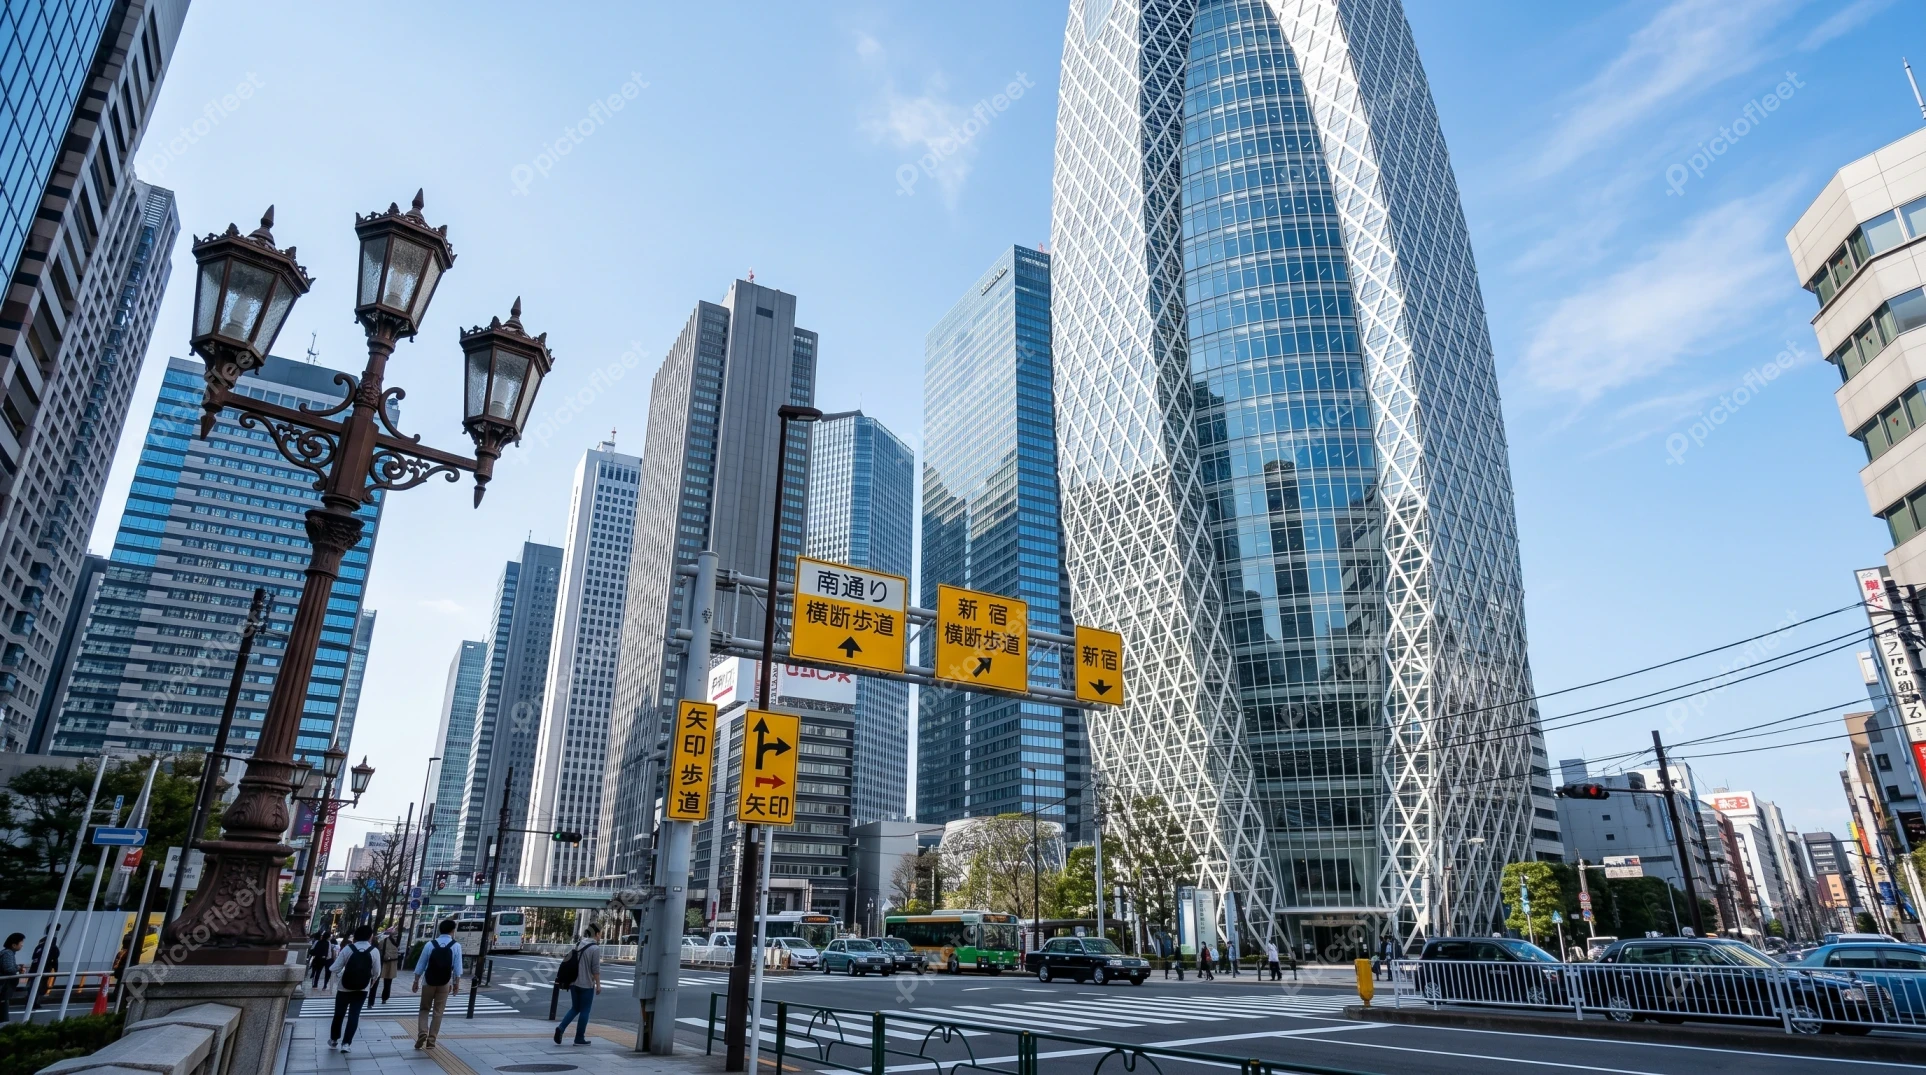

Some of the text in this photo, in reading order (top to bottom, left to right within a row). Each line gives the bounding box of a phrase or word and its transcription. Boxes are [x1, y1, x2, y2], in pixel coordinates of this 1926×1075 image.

[817, 570, 887, 603] 南通り
[806, 600, 894, 637] 横断歩道
[945, 621, 1021, 656] 横断歩道
[1083, 645, 1118, 671] 新宿
[677, 707, 708, 815] 矢印歩道
[745, 792, 789, 818] 矢印
